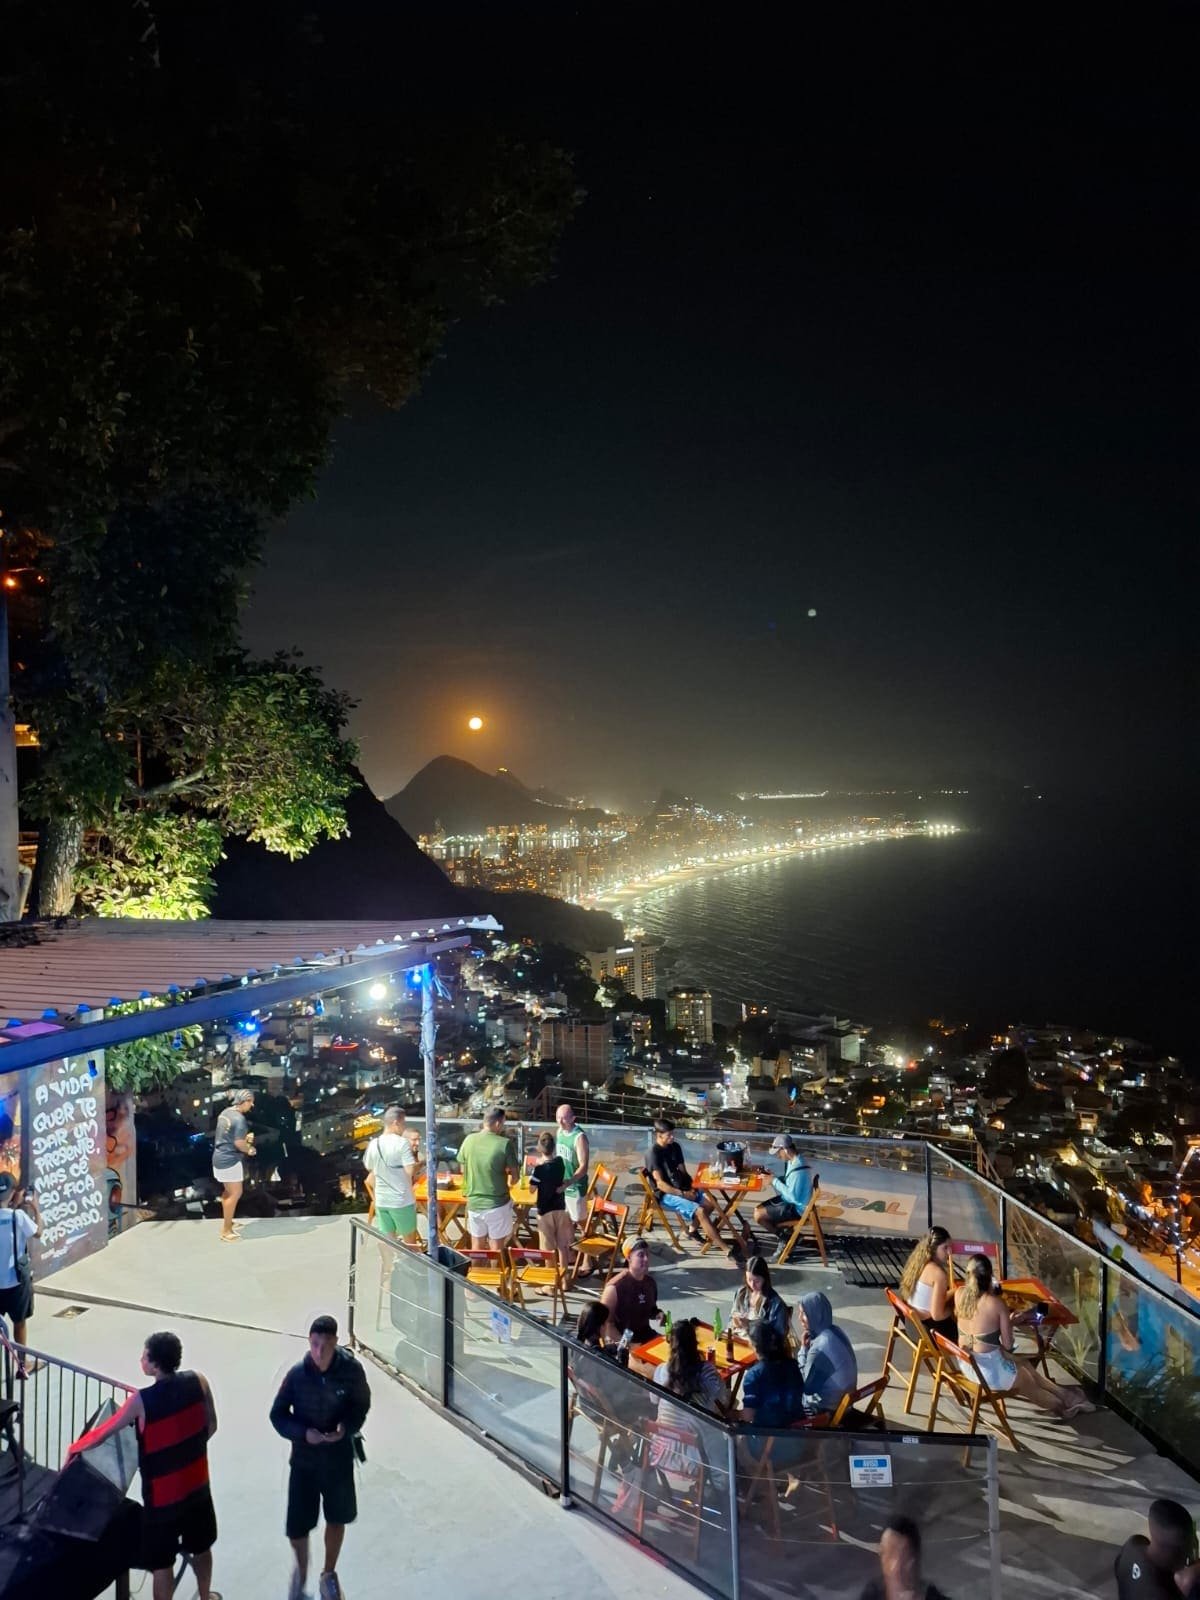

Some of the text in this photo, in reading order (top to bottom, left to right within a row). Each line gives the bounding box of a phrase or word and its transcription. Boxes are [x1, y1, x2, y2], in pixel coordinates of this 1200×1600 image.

[35, 1073, 93, 1106] A VIDA
[33, 1097, 97, 1133] QUER TE
[32, 1118, 98, 1155] DAR UM
[35, 1168, 67, 1194] MAS
[40, 1190, 103, 1228] RESO NO
[40, 1208, 104, 1246] PASSADO.
